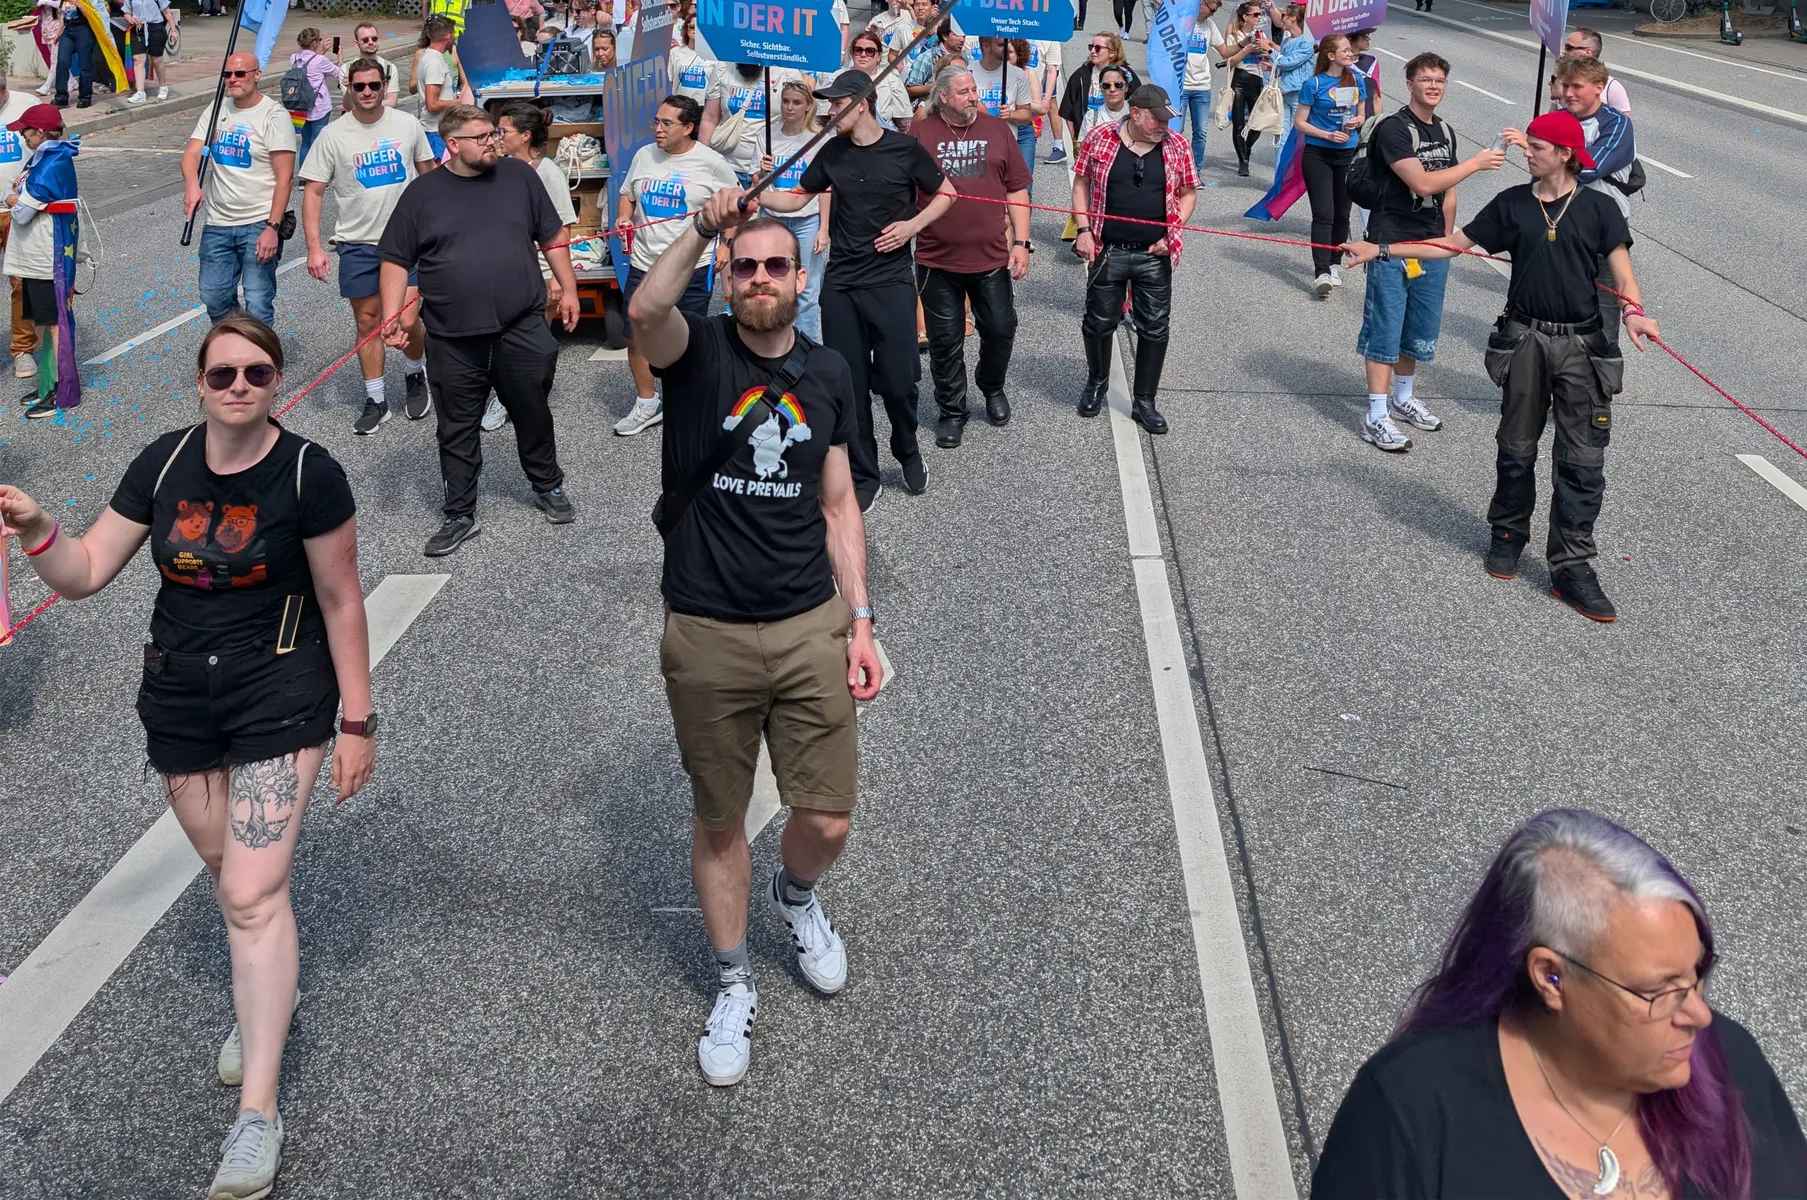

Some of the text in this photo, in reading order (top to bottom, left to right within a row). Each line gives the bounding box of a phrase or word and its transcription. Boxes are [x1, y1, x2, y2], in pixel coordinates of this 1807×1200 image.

[734, 2, 784, 34] DER
[794, 8, 817, 36] IT
[991, 17, 1008, 25] Unser
[1022, 19, 1040, 27] Stack:
[996, 25, 1019, 33] Vielfalt!
[740, 39, 792, 52] Sicher. Sichtbar.
[746, 50, 808, 63] Selbstverständlich.
[753, 102, 760, 110] IT
[7, 144, 15, 153] IT
[219, 147, 235, 157] DER
[237, 149, 245, 158] IT
[937, 140, 988, 158] SANKT
[353, 149, 396, 169] QUEER
[355, 162, 398, 179] IN DER IT
[641, 178, 682, 197] QUEER
[652, 197, 670, 207] DER
[672, 198, 680, 209] IT
[713, 472, 802, 498] LOVE PREVAILS
